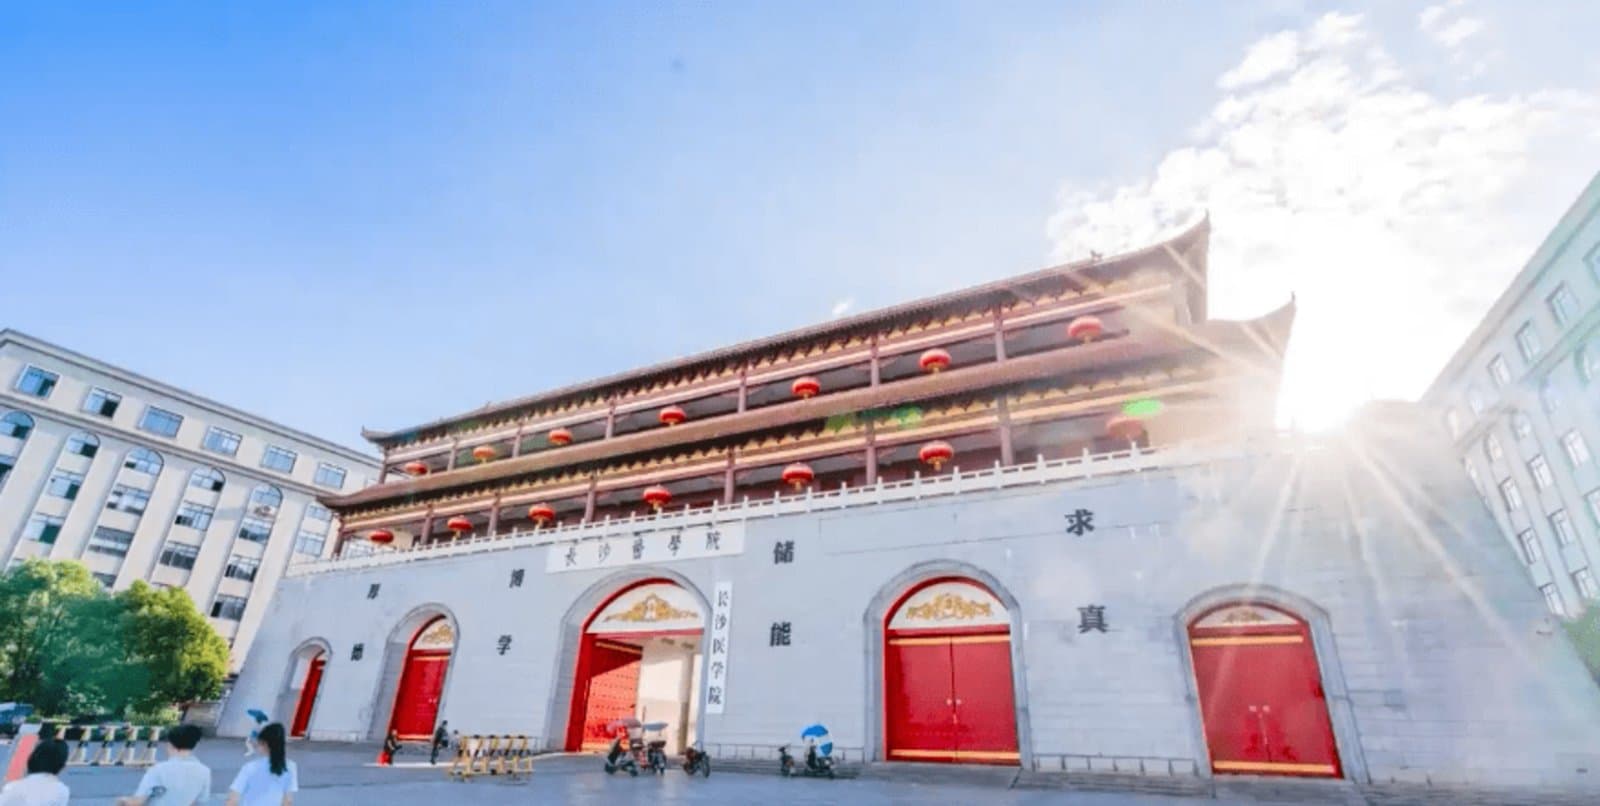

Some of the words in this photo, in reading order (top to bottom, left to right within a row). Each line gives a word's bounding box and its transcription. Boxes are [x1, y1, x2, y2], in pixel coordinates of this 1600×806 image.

[769, 540, 795, 647] 储能
[1064, 509, 1109, 633] 求真
[708, 590, 728, 704] 长沙医学院
